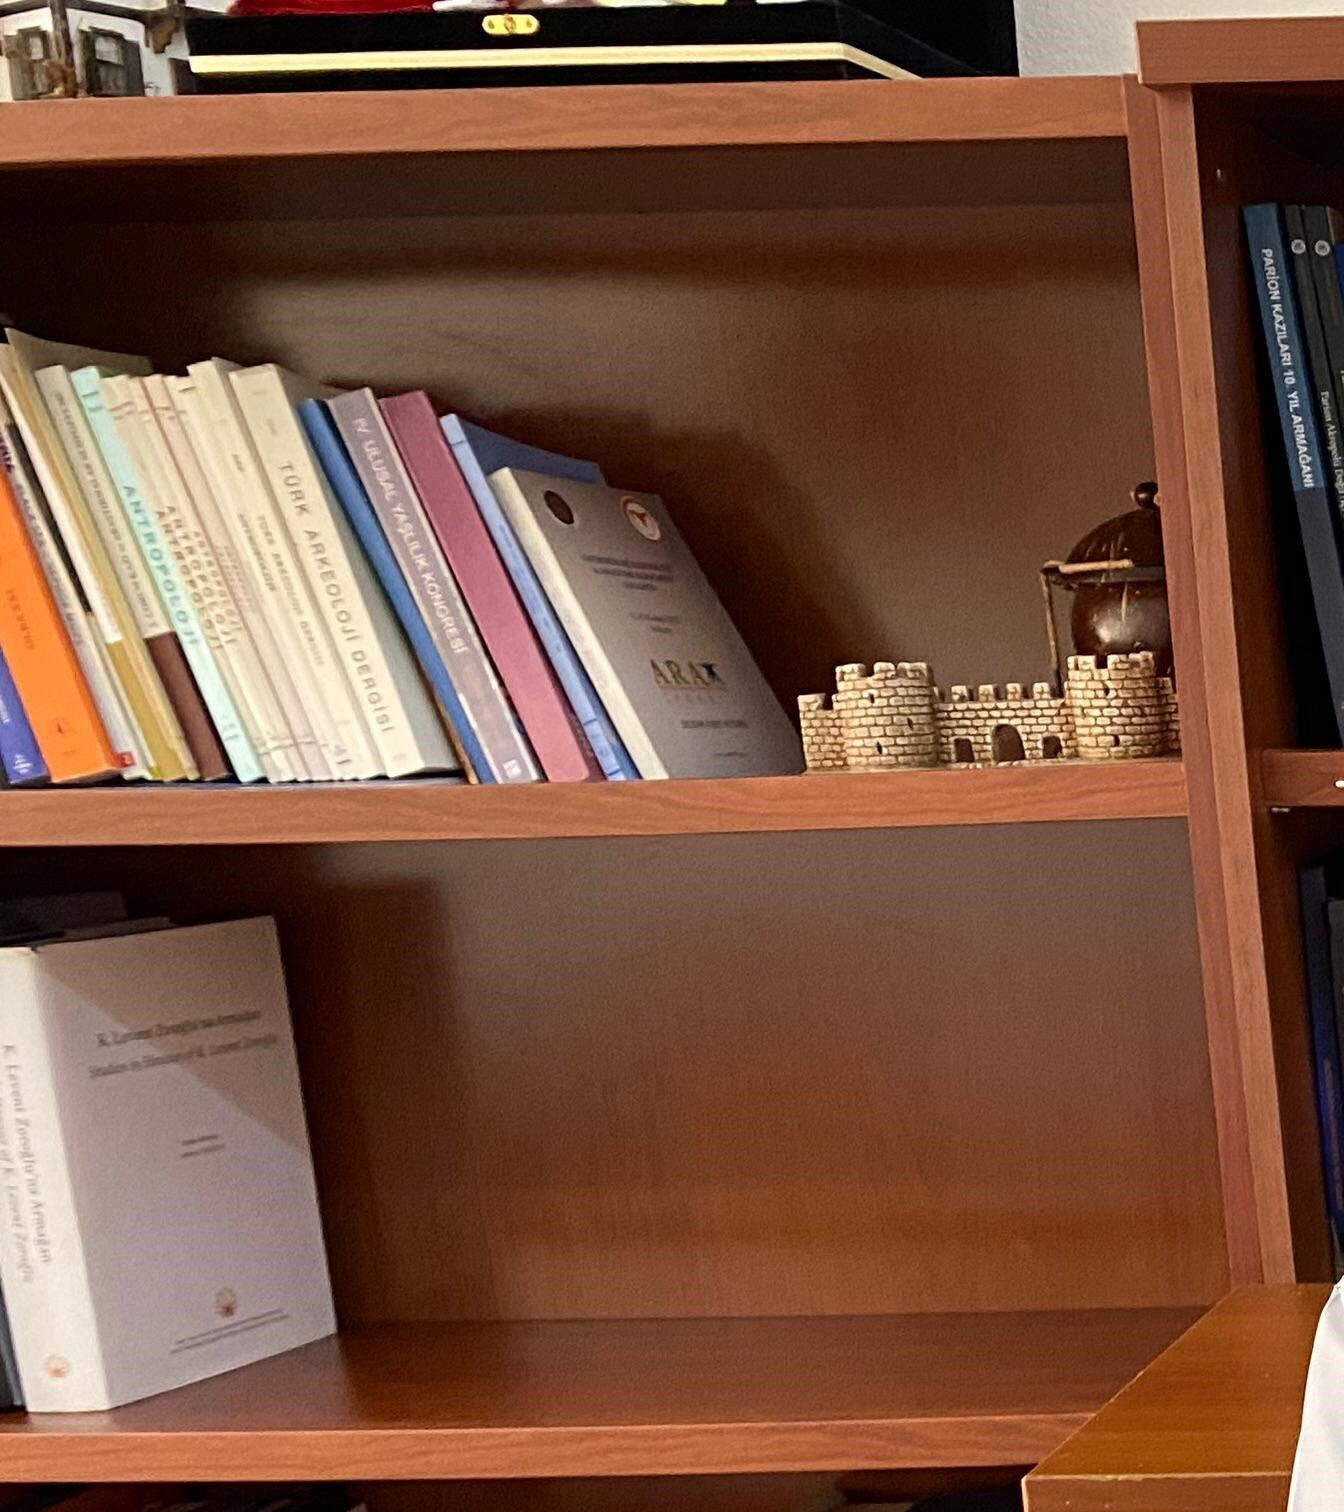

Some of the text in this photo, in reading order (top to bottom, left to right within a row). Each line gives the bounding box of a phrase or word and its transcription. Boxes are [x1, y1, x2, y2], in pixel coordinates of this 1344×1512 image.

[1262, 248, 1280, 300] PARİON
[1272, 303, 1292, 366] KAZILARI
[1287, 391, 1300, 412] YIL
[1291, 414, 1314, 488] ARMAĞANI
[363, 439, 468, 654] ULUSAL YAŞLILIK KONGRESİ
[279, 463, 394, 733] TÜRK ARKEOLOJİ DERGİSİ
